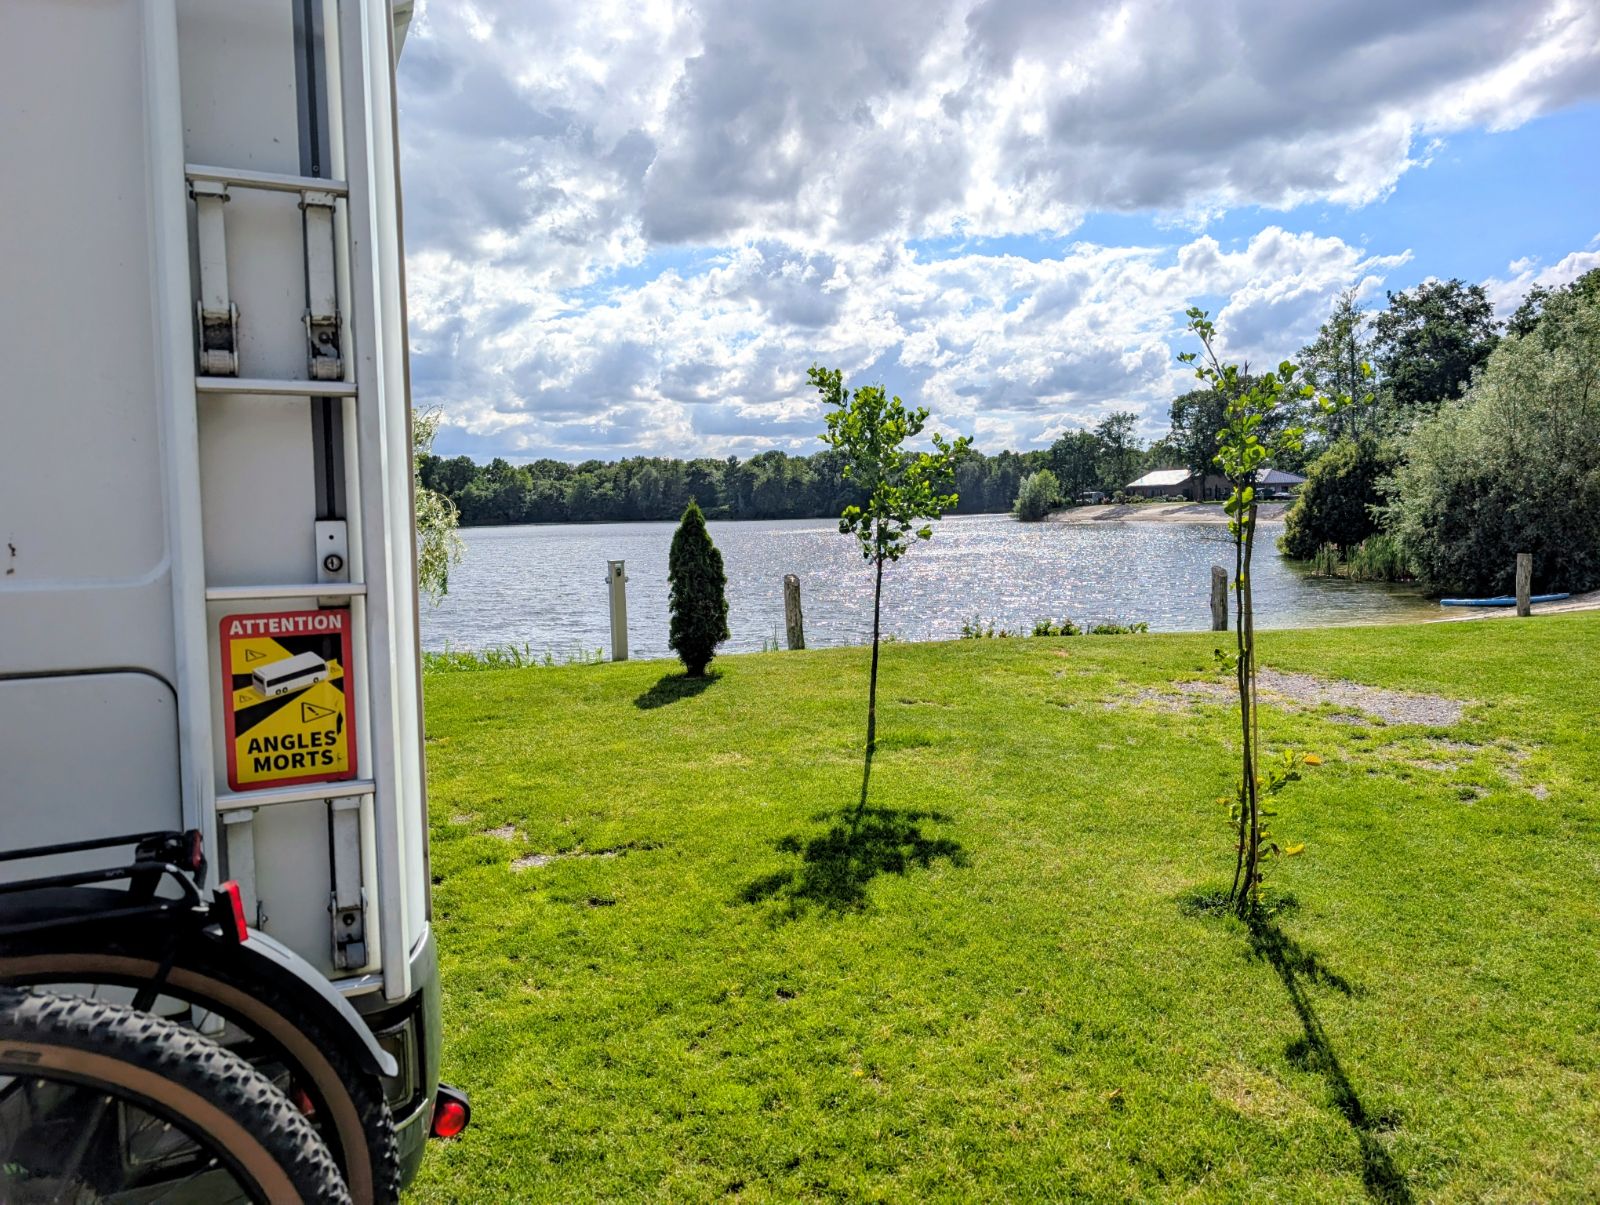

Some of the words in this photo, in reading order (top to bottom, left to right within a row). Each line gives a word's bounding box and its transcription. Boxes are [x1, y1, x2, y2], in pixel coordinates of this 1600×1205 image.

[230, 614, 342, 635] ATTENTION
[247, 730, 337, 754] ANGLES
[253, 749, 334, 773] MORTS
